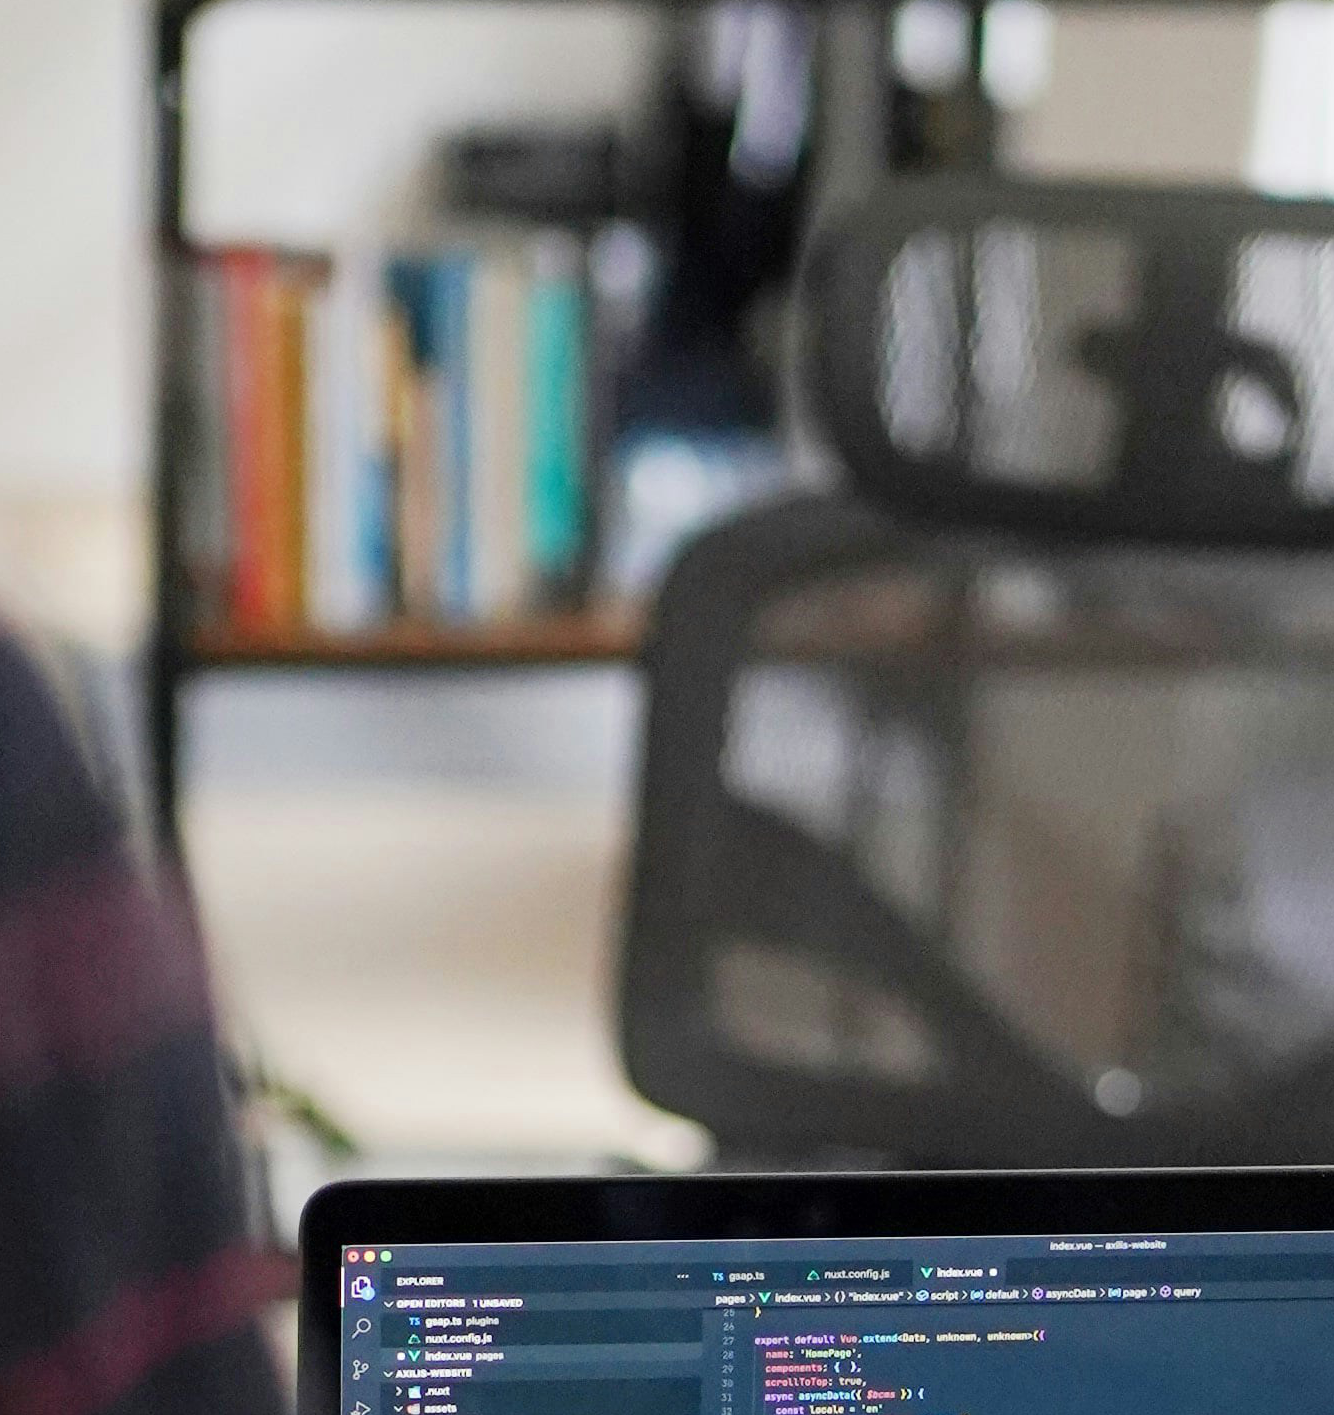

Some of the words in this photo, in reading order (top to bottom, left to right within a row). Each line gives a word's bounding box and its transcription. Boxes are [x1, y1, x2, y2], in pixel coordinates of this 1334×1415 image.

[1050, 1241, 1093, 1251] index.vue
[713, 1272, 724, 1282] TS
[729, 1271, 765, 1283] gsap.ts
[824, 1268, 890, 1281] nuxt.config.js
[937, 1267, 983, 1278] index.vue
[397, 1276, 444, 1287] EXPLORER
[715, 1294, 746, 1306] pages
[775, 1292, 822, 1304] index.vue
[930, 1290, 959, 1302] script
[985, 1288, 1020, 1301] default
[1046, 1287, 1097, 1301] asyncData
[1122, 1288, 1148, 1300] page
[1173, 1287, 1202, 1299] query
[396, 1299, 423, 1309] OPEN
[425, 1298, 465, 1308] EDITORS
[473, 1299, 477, 1308] 1
[479, 1298, 523, 1308] UNSAVED
[409, 1317, 420, 1326] TS
[425, 1317, 462, 1328] gsap.ts
[466, 1316, 499, 1327] plugins
[425, 1332, 492, 1345] nuxt.config.js
[754, 1335, 789, 1348] export
[794, 1334, 835, 1345] default
[936, 1332, 981, 1343] unknown,
[425, 1351, 472, 1362] index.vue
[476, 1352, 504, 1362] pages
[765, 1348, 793, 1360] name:
[395, 1367, 472, 1379] AXILIS-WEBSITE
[765, 1363, 827, 1375] components:
[765, 1376, 832, 1388] scrollToTop:
[839, 1377, 866, 1388] true,
[764, 1393, 793, 1403] async
[424, 1403, 457, 1414] assets
[809, 1404, 844, 1415] locale
